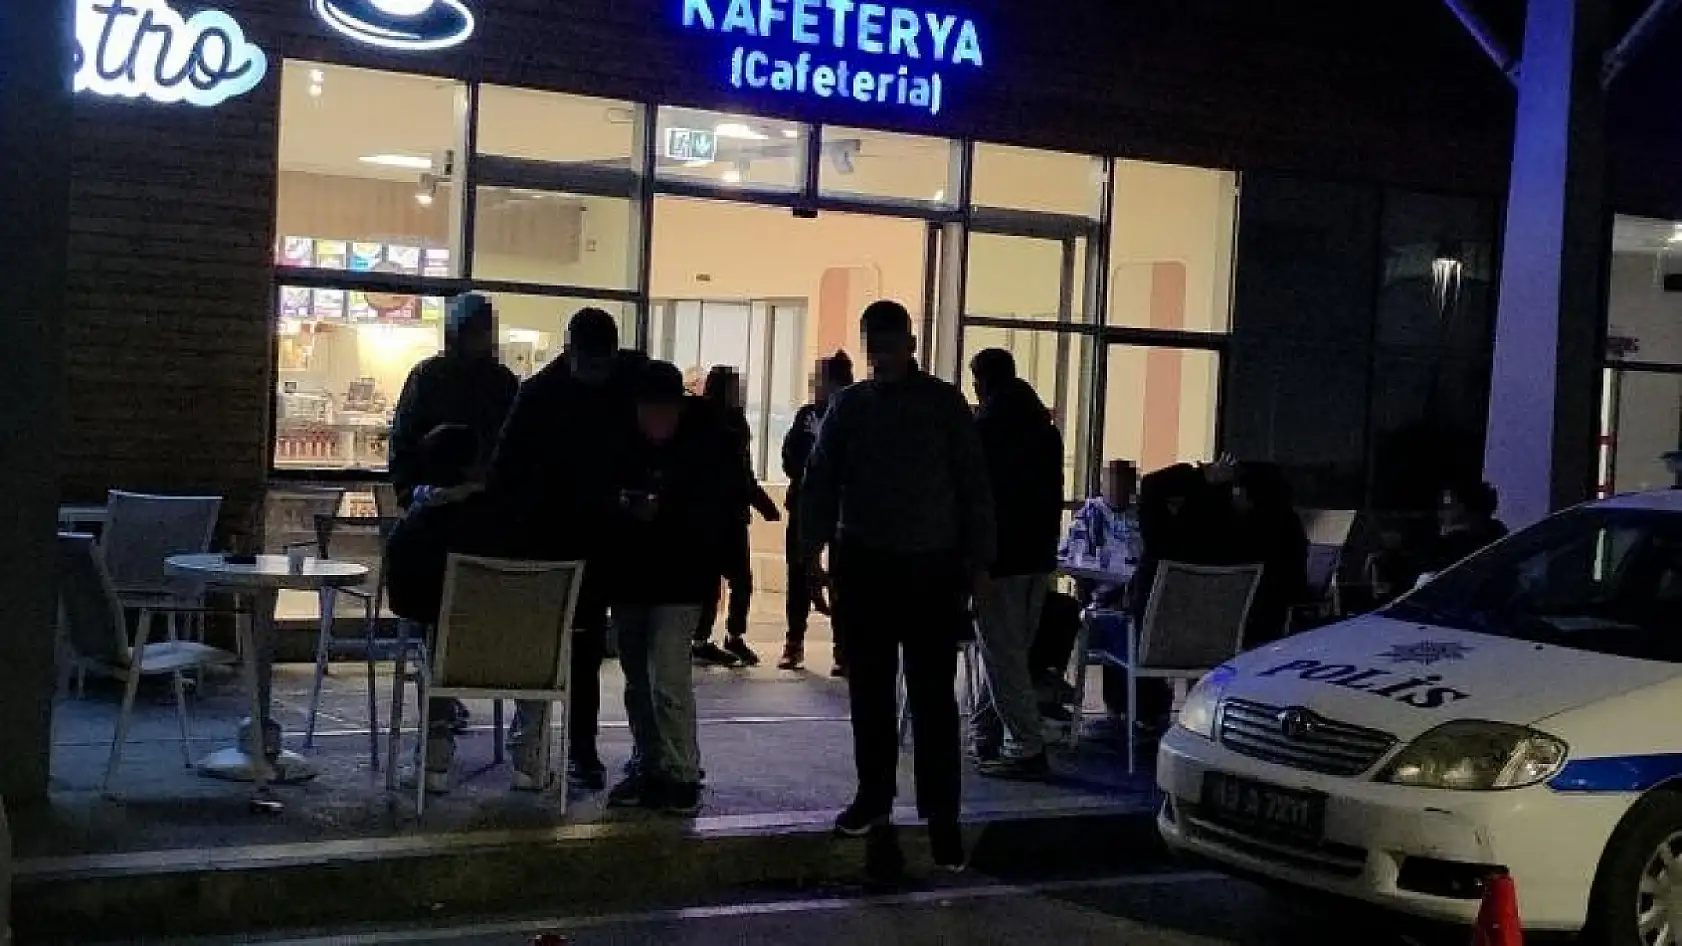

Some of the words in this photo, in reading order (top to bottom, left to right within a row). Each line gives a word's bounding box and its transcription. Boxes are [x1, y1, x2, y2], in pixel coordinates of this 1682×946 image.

[74, 0, 252, 90] tro
[682, 0, 983, 66] KAFETERYA
[731, 46, 943, 115] (Cafeteria)
[1256, 659, 1472, 708] POLİS
